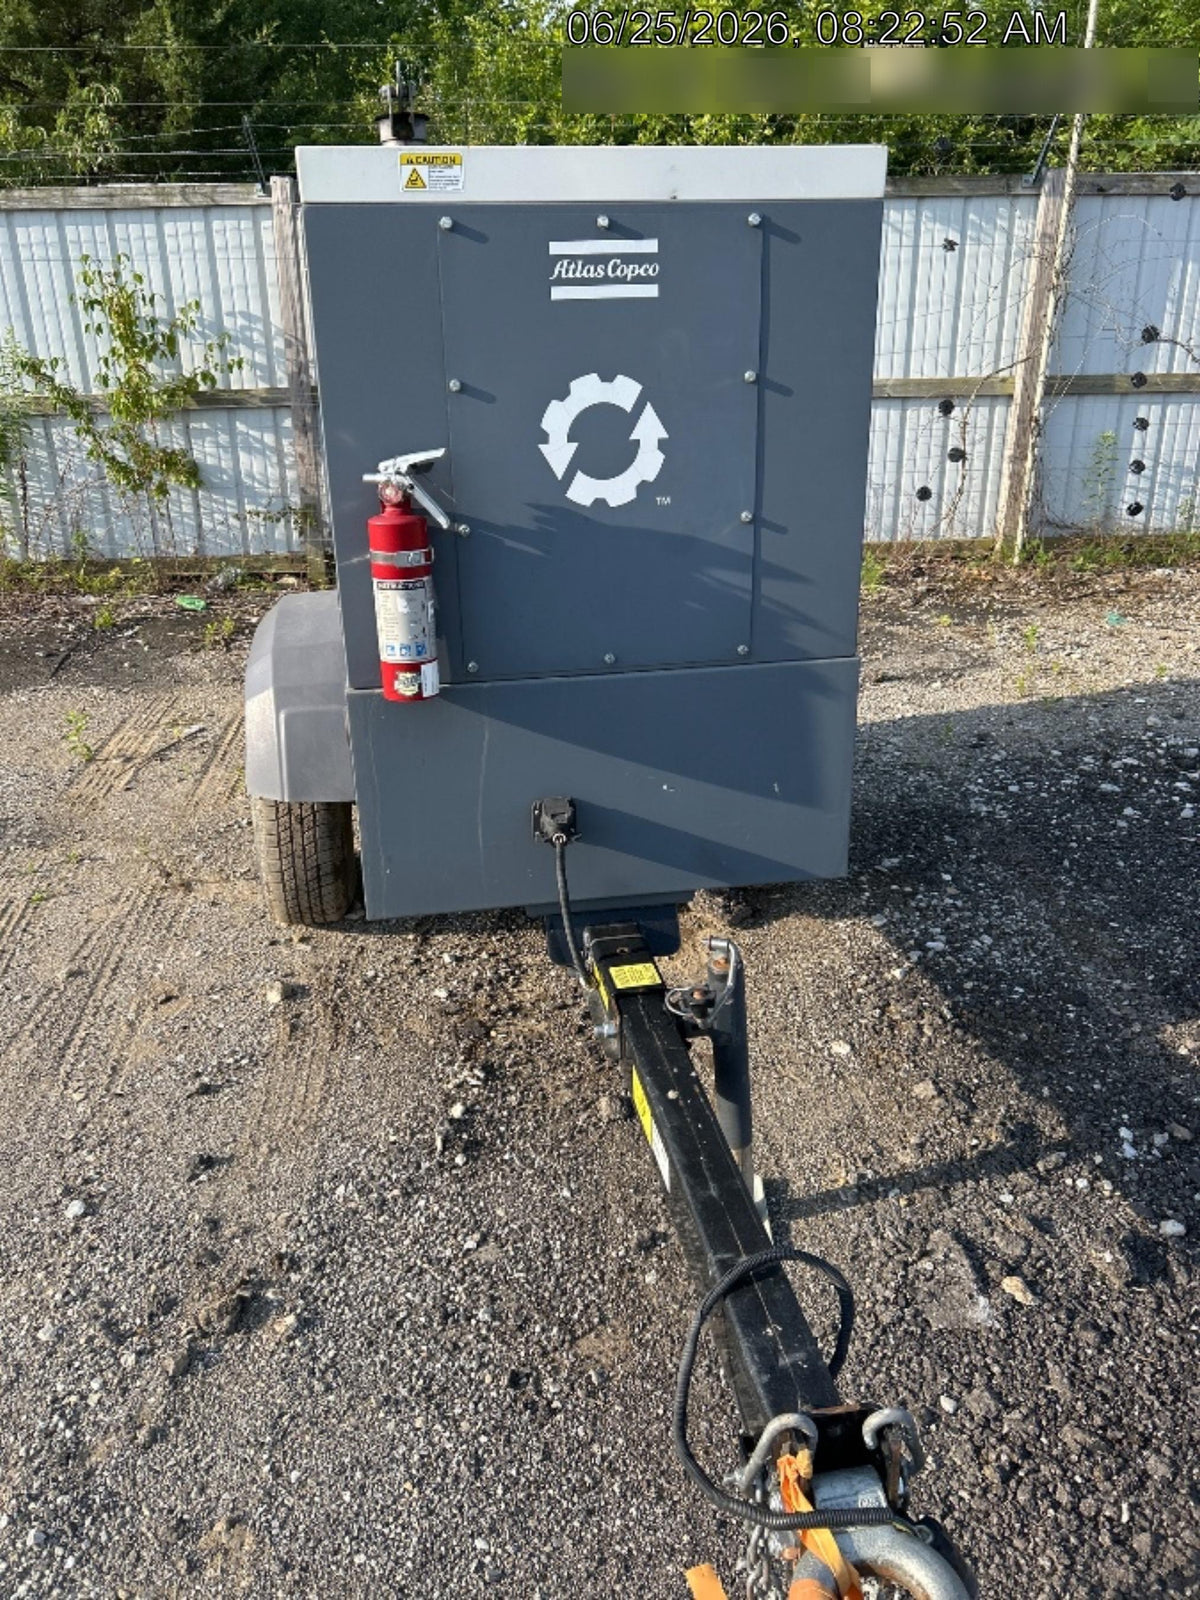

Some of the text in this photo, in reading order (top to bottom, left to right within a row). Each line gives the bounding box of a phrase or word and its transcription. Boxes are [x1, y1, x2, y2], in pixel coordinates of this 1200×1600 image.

[415, 155, 456, 164] CAUTION
[549, 258, 660, 282] Atlas Copco
[656, 496, 671, 506] TM
